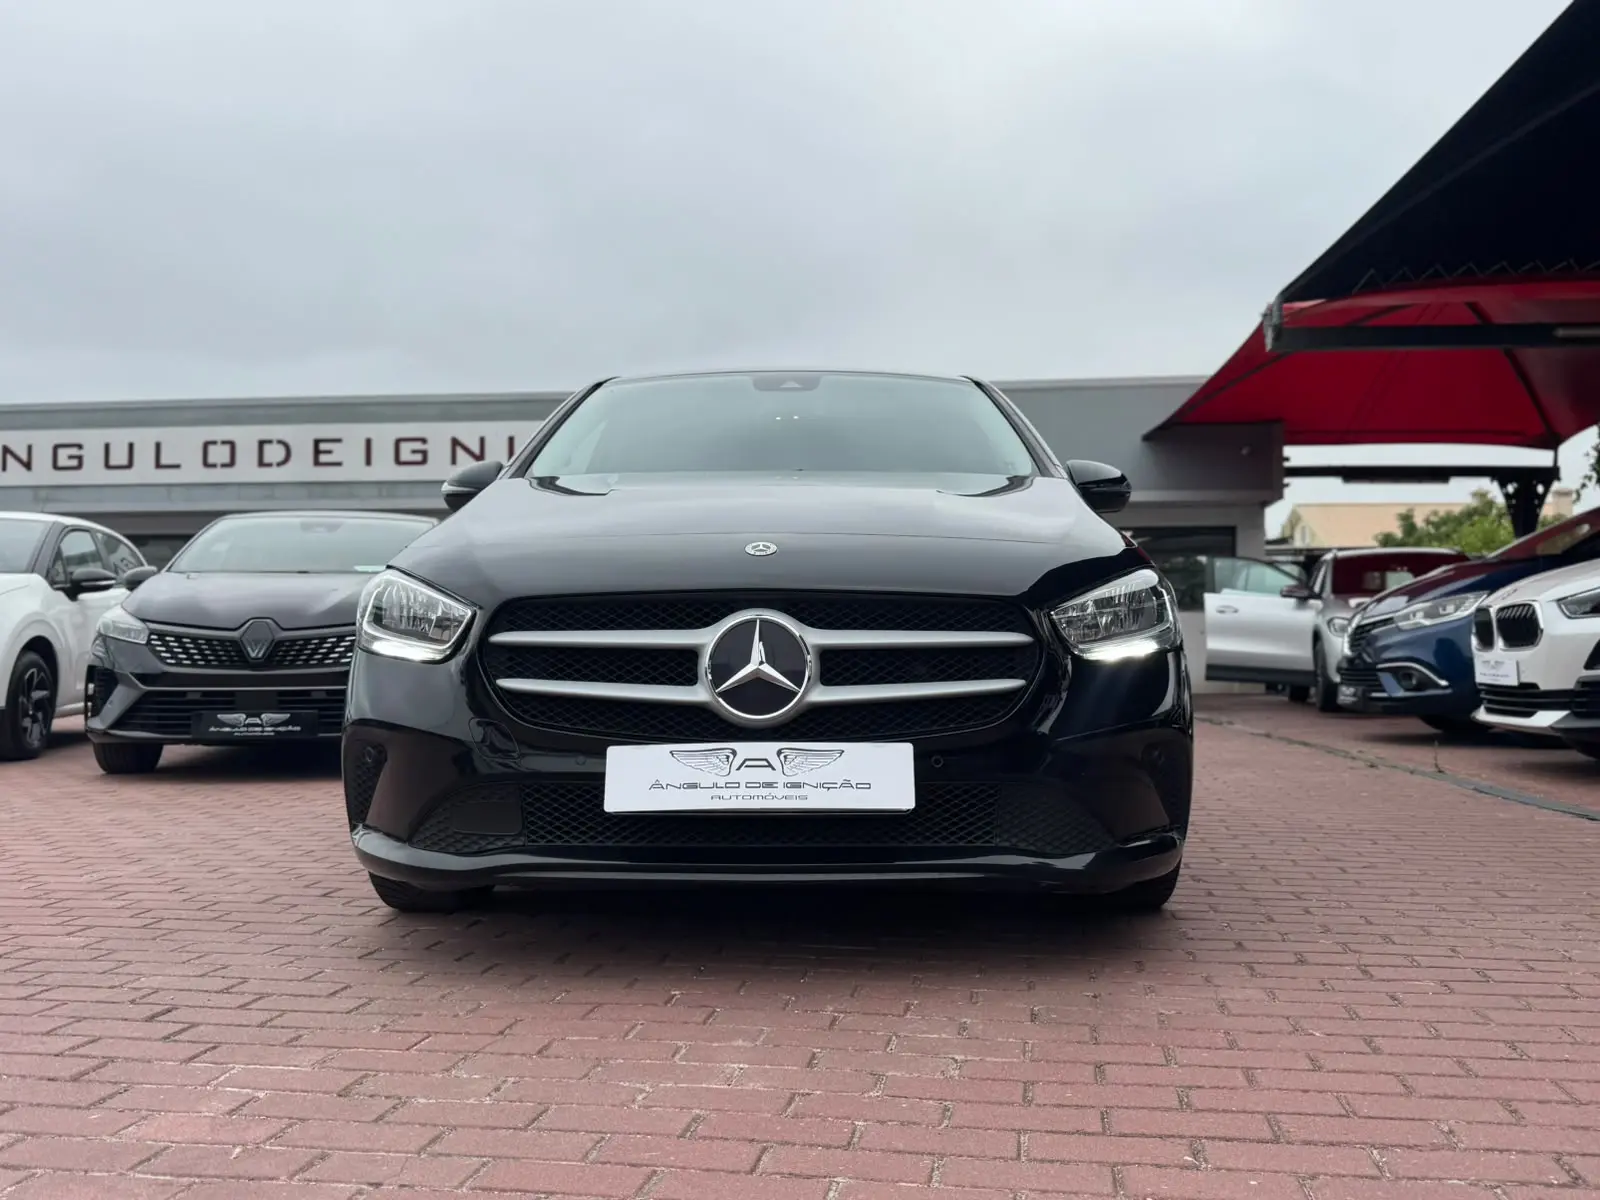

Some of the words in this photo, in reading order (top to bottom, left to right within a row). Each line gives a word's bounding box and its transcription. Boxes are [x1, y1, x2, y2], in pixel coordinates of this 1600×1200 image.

[648, 778, 741, 790] ÂNGULO
[744, 781, 779, 789] DE
[783, 778, 872, 792] IGNIÇÃO
[710, 792, 809, 801] AUTOMÓVEIS
